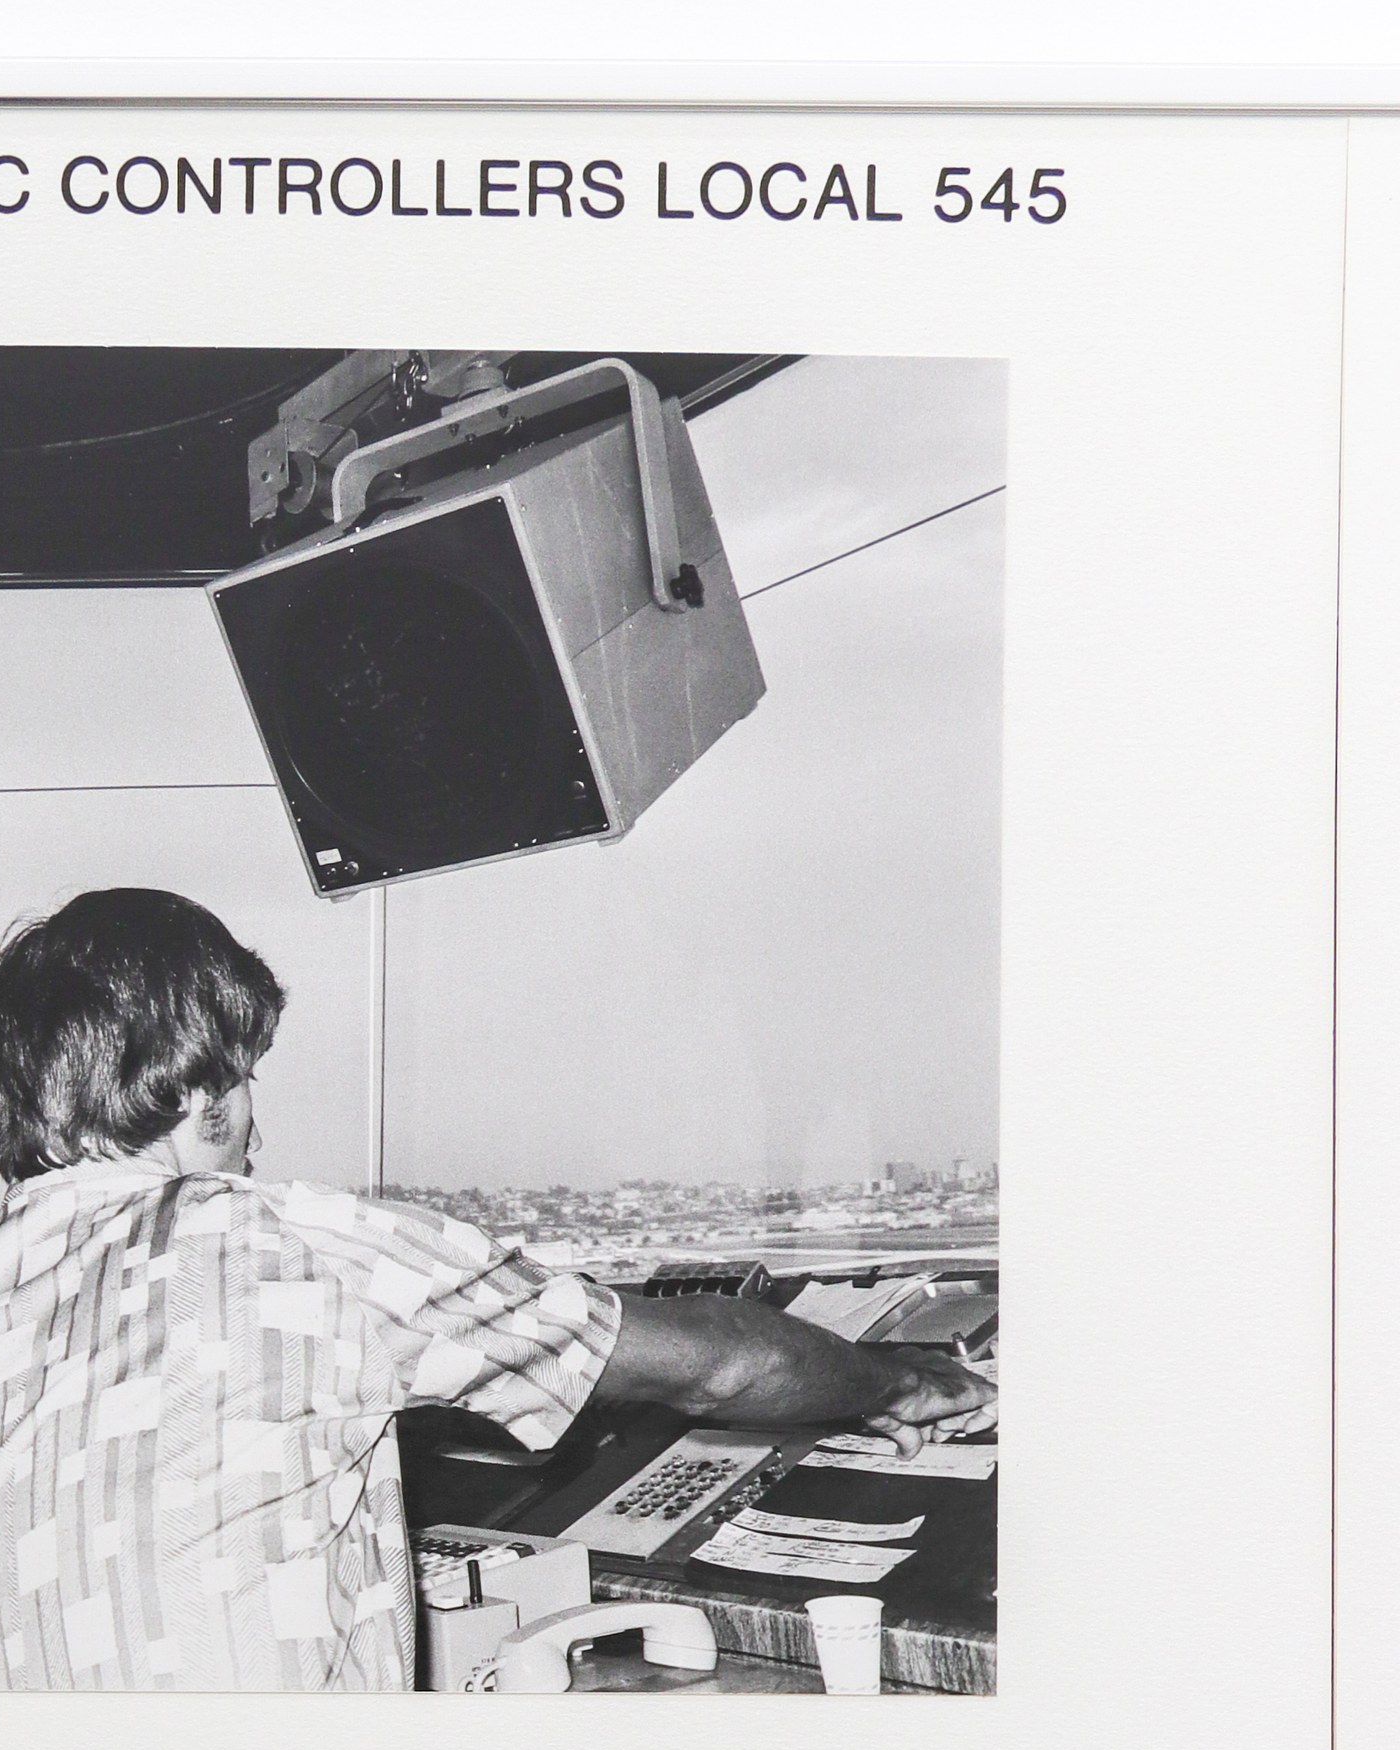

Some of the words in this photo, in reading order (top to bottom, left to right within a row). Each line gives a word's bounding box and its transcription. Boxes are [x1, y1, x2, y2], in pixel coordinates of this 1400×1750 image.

[62, 156, 624, 218] CONTROLLERS
[658, 162, 902, 221] LOCAL
[935, 168, 1066, 224] 545
